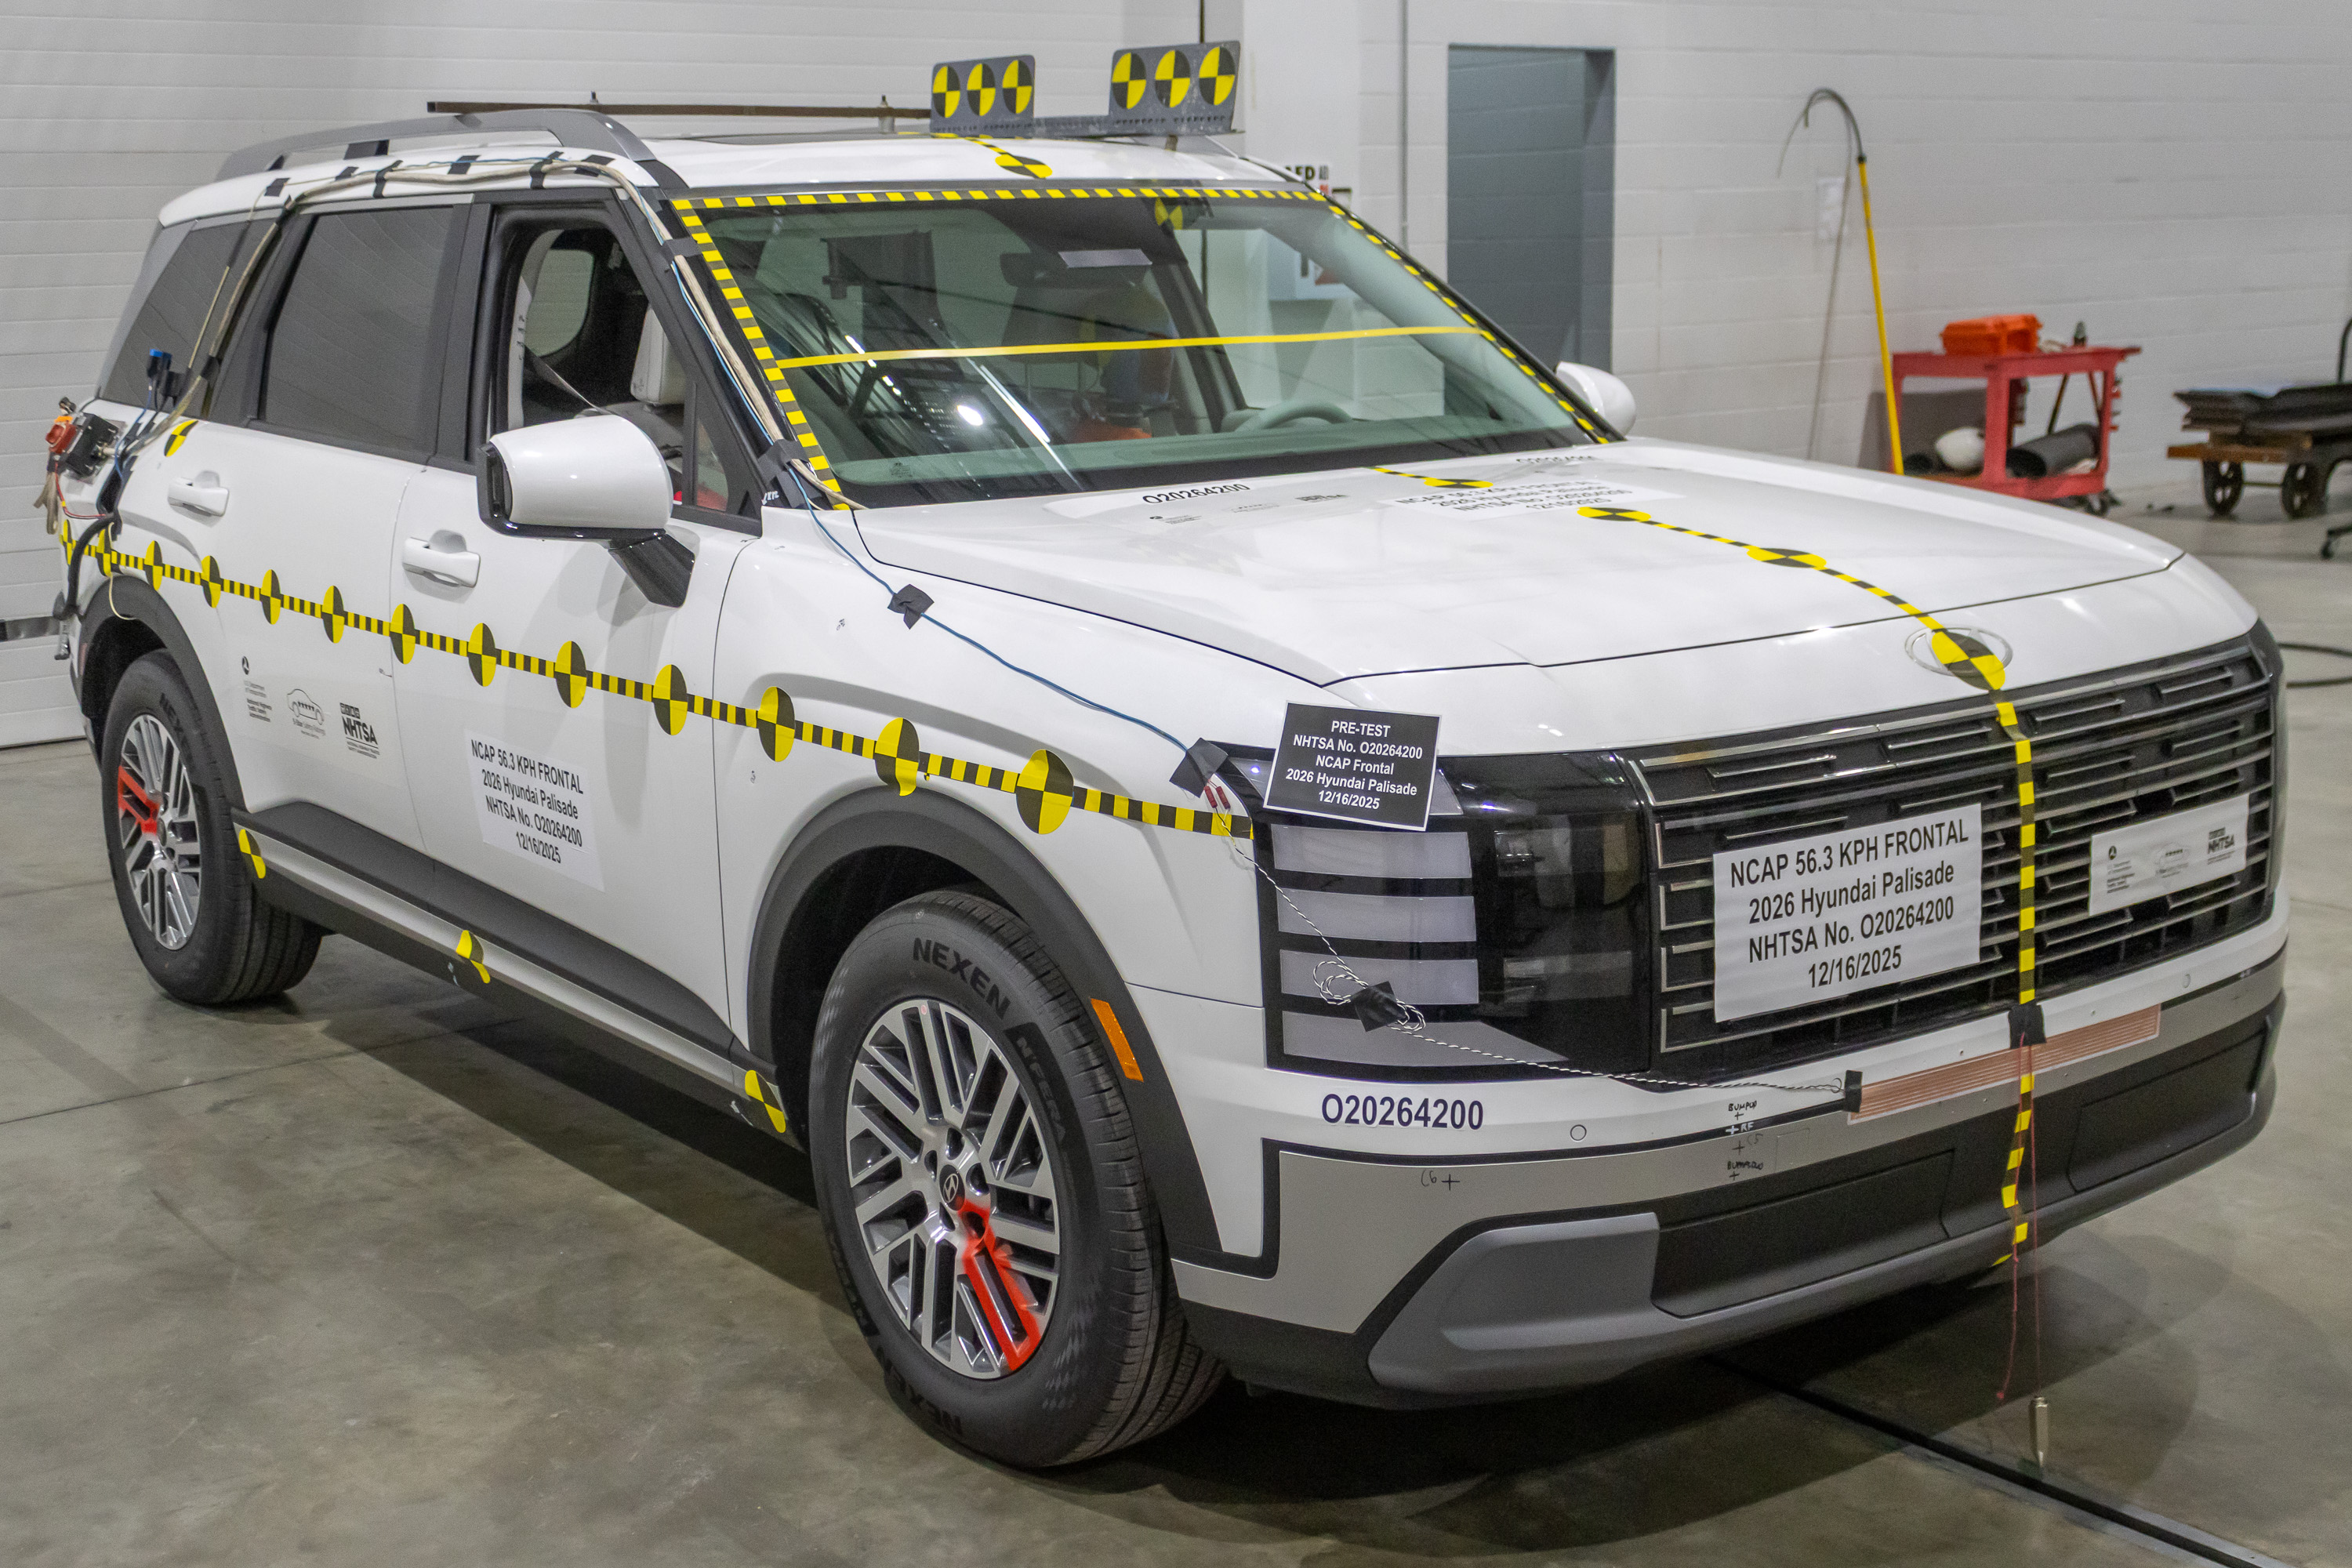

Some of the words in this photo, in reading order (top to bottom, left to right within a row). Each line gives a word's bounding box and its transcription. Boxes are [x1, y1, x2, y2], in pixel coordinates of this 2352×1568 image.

[1142, 484, 1251, 504] O20264200
[341, 715, 378, 746] NHTSA
[1293, 734, 1334, 751] NHTSA
[1338, 739, 1356, 753] No.
[1359, 742, 1423, 760] O20264200
[1330, 720, 1391, 738] PRE-TEST
[470, 739, 495, 763] NCAP
[498, 749, 515, 771] 56.3
[517, 755, 537, 778] KPH
[538, 761, 584, 795] FRONTAL
[1286, 768, 1314, 783] 2026
[1316, 772, 1366, 790] Hyundai
[1368, 779, 1417, 796] Palisade
[1316, 755, 1351, 771] NCAP
[1353, 759, 1395, 775] Frontal
[481, 769, 502, 791] 2026
[503, 776, 539, 805] Hyundai
[539, 789, 579, 820] Palisade
[1318, 790, 1380, 810] 12/16/2025
[485, 795, 517, 822] NHTSA
[517, 807, 534, 828] No.
[534, 813, 583, 848] O20264200
[516, 831, 561, 864] 12/16/2025
[1730, 853, 1789, 887] NCAP
[1795, 845, 1833, 876] 56.3
[1839, 835, 1879, 868] KPH
[1885, 818, 1969, 858] FRONTAL
[1749, 891, 1795, 924] 2026
[1801, 875, 1877, 917] Hyundai
[1882, 860, 1955, 897] Palisade
[1748, 926, 1819, 964] NHTSA
[1824, 921, 1854, 946] No.
[1860, 895, 1955, 939] O20264200
[912, 937, 1011, 1020] NEXEN
[1808, 945, 1903, 989] 12/16/2025
[1321, 1093, 1484, 1130] O20264200
